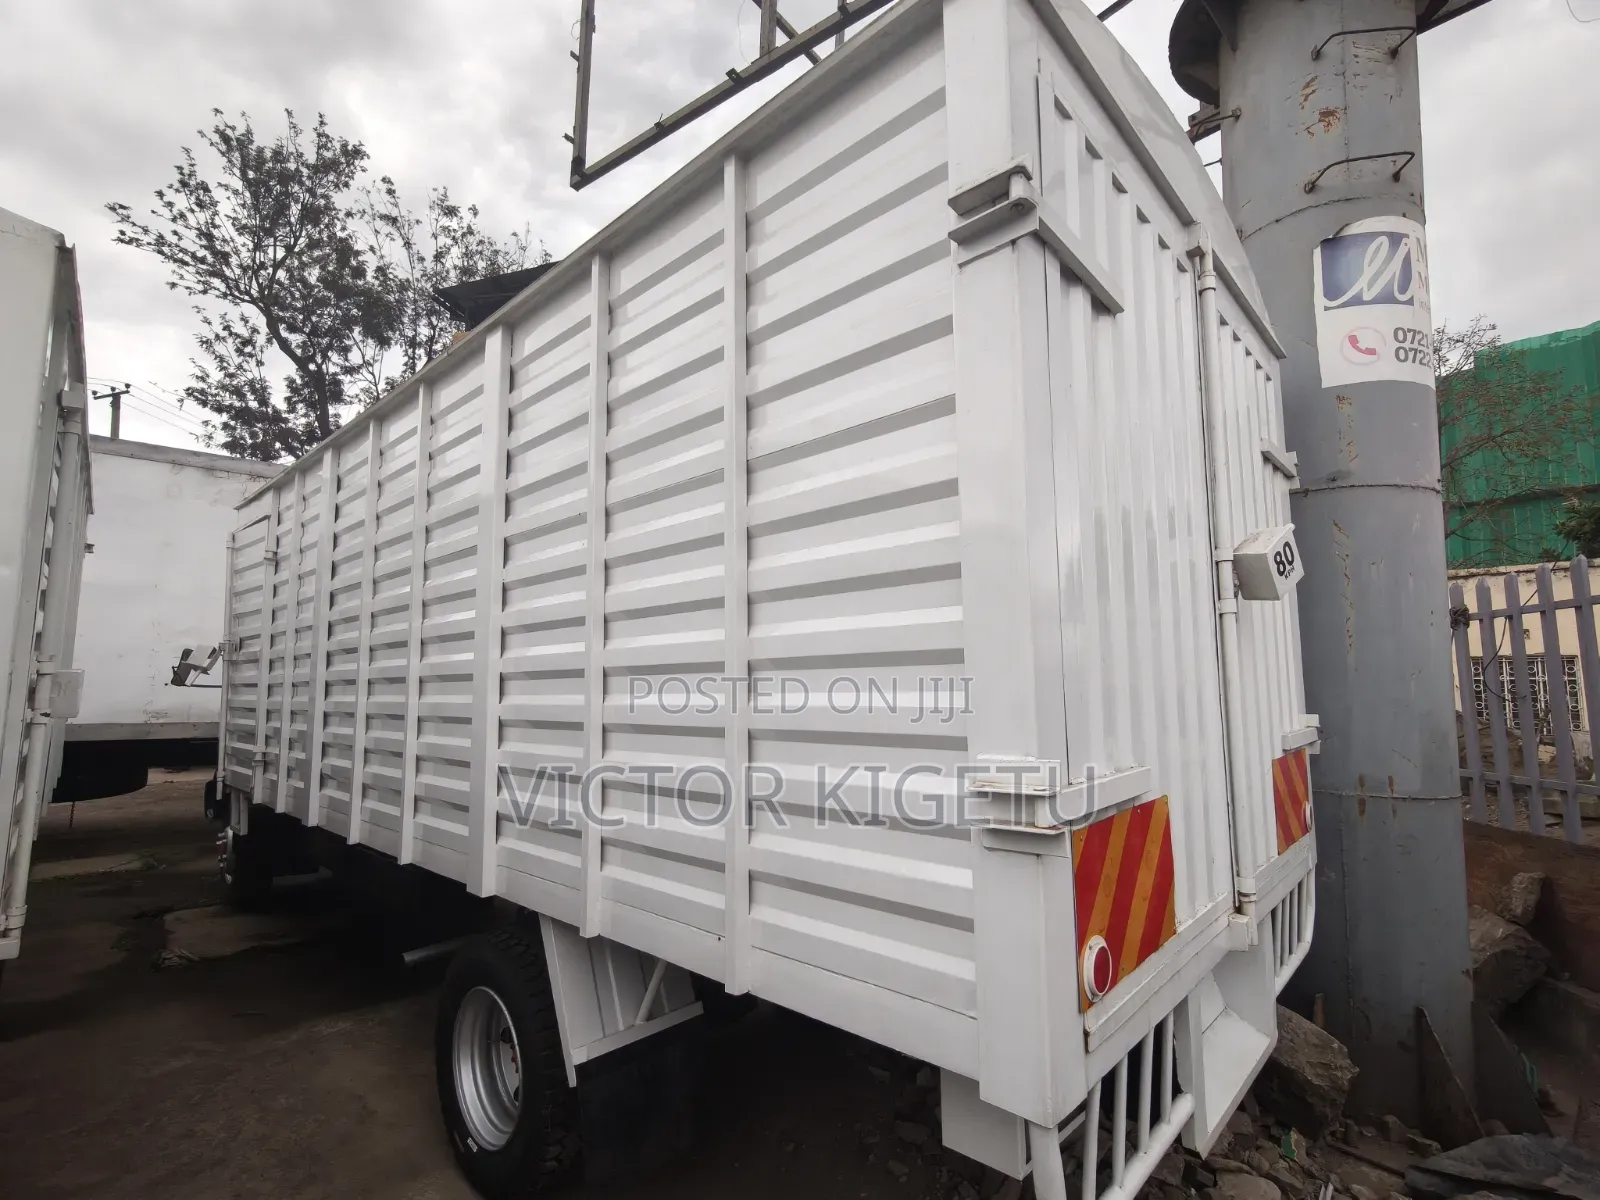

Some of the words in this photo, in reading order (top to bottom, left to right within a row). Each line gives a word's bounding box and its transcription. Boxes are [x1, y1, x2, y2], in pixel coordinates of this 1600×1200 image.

[1393, 327, 1432, 350] 0721
[1394, 345, 1433, 370] 0722
[1273, 540, 1295, 577] 80
